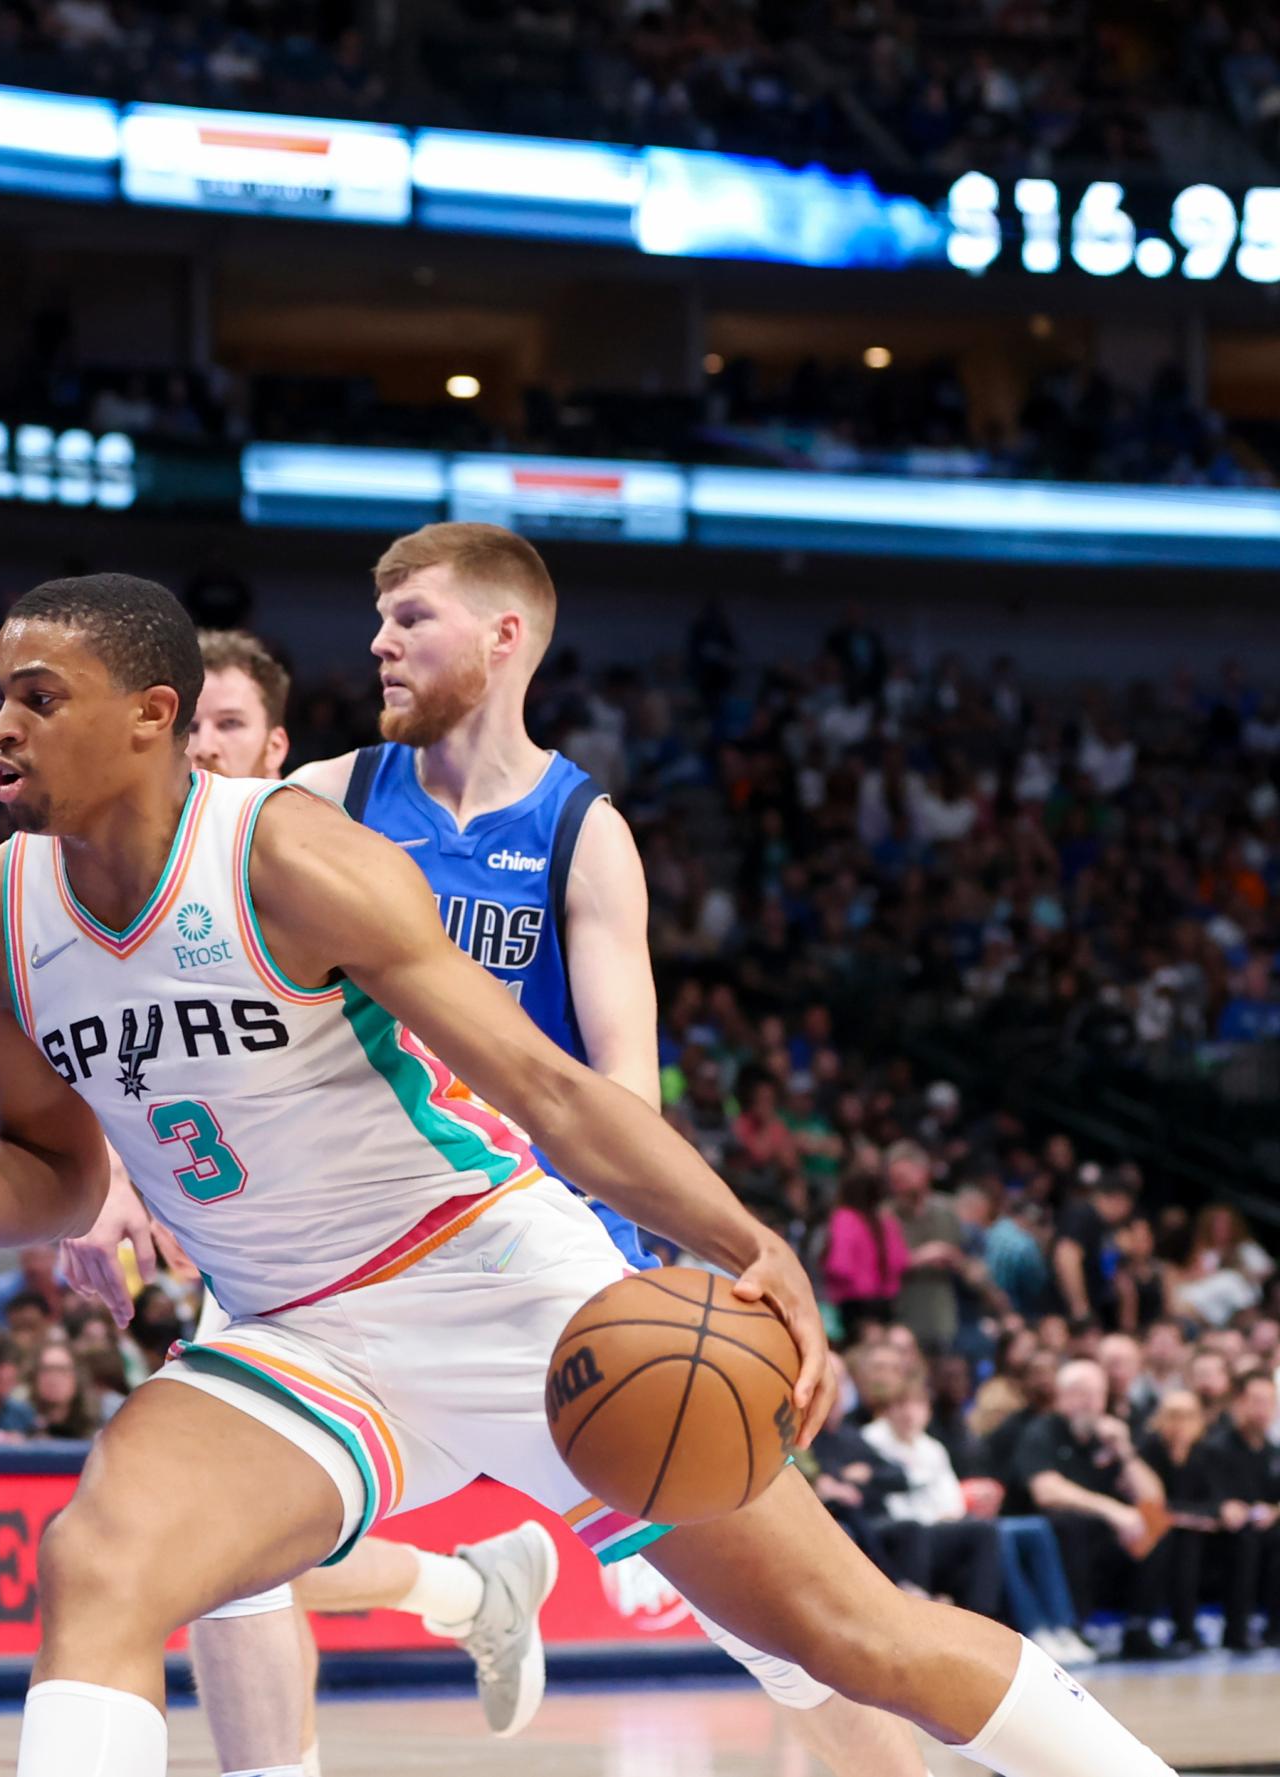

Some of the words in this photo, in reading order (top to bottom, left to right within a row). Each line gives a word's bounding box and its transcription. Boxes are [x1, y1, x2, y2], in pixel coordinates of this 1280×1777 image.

[487, 849, 547, 872] chime
[173, 938, 233, 970] Frost
[42, 999, 290, 1102] SPURS
[147, 1100, 249, 1206] 3
